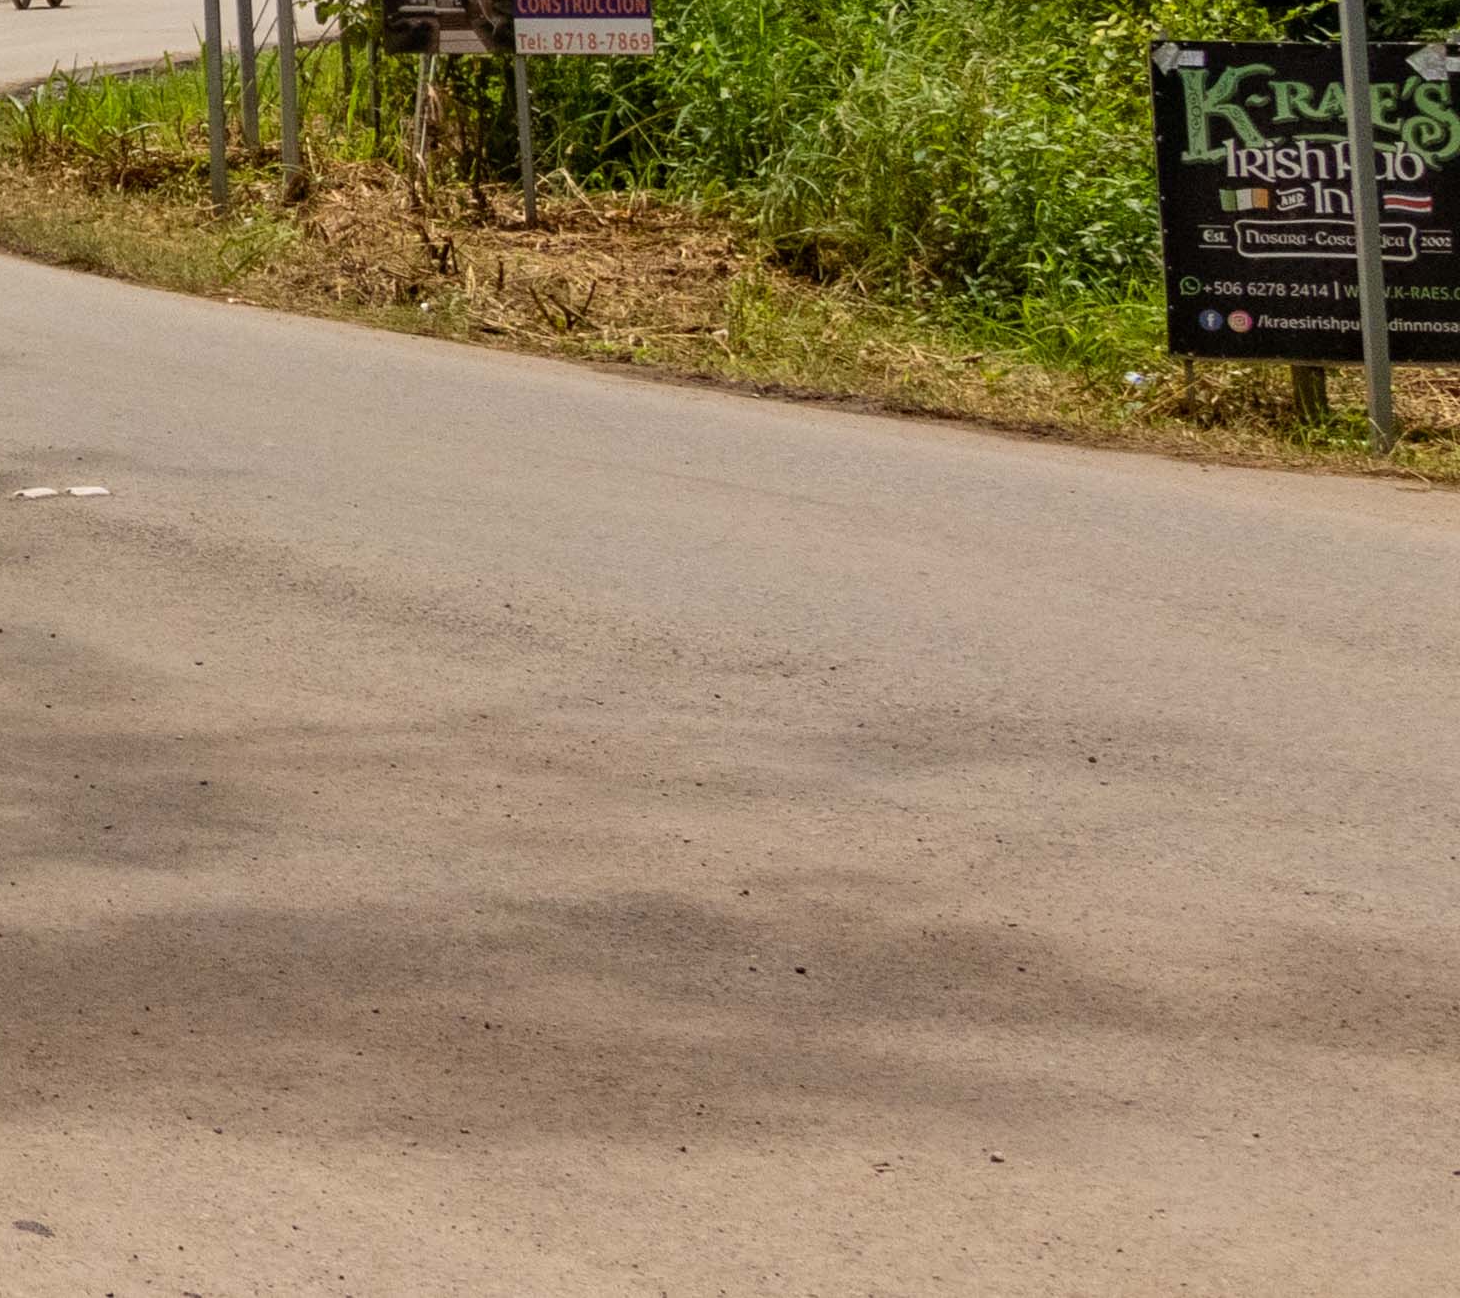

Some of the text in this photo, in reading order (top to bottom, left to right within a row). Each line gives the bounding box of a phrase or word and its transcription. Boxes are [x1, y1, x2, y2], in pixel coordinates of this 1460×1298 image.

[518, 32, 651, 51] Tel: 8718-7869
[1279, 193, 1305, 207] AND
[1421, 236, 1452, 248] 2002
[1203, 280, 1243, 296] +506
[1247, 281, 1286, 297] 6278
[1291, 282, 1329, 298] 2414
